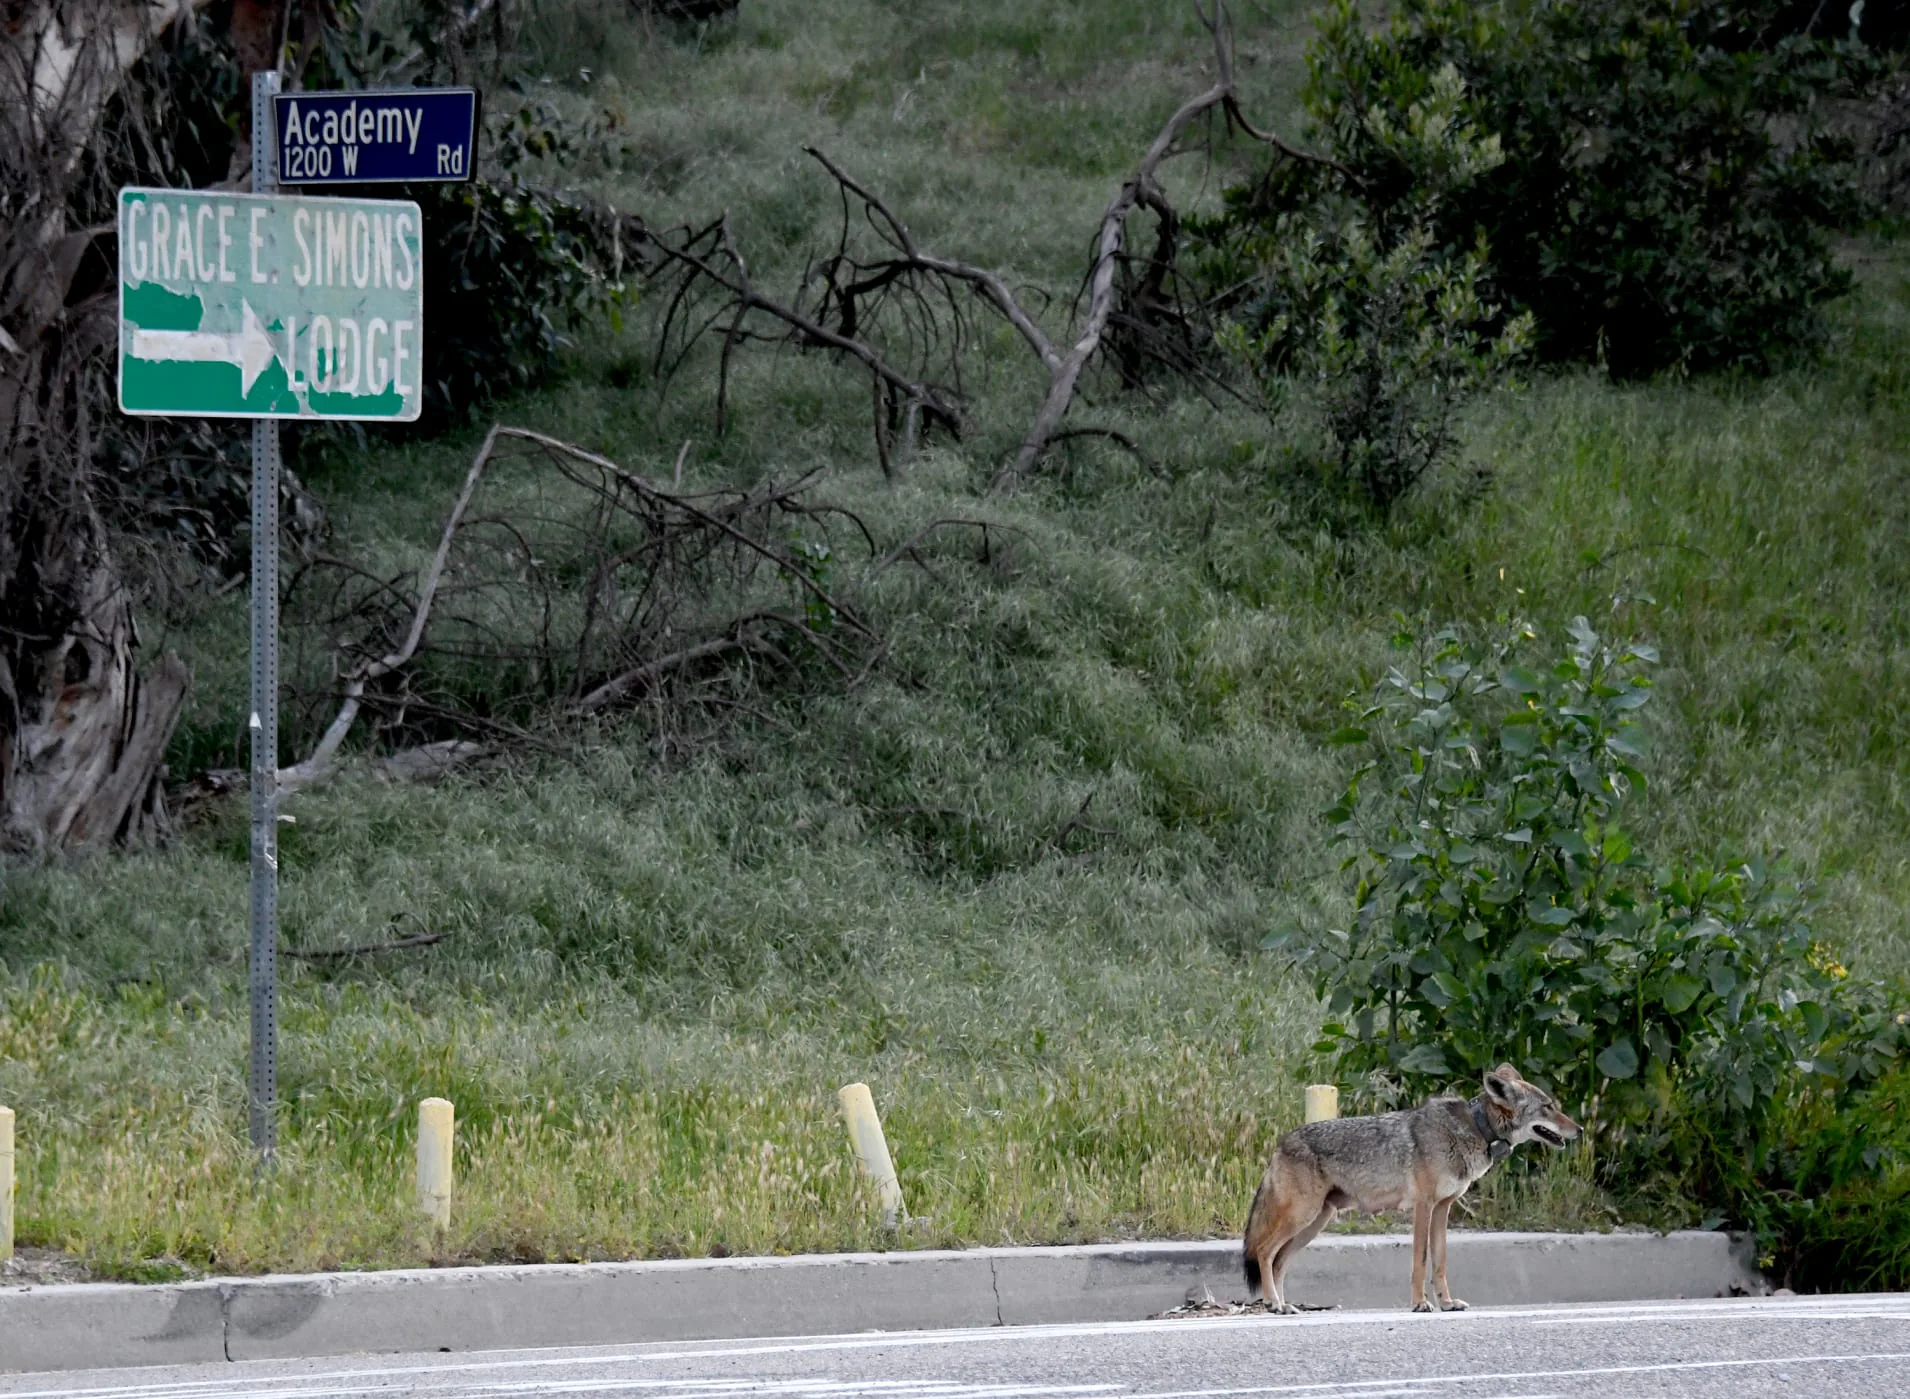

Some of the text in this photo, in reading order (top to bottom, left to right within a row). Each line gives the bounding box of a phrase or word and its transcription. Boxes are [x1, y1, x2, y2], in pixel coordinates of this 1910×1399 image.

[284, 100, 423, 155] Academy
[284, 145, 359, 178] 1200 W
[437, 144, 463, 175] Rd
[128, 200, 414, 290] GRACE E. SIMONS
[287, 314, 413, 396] LODGE
